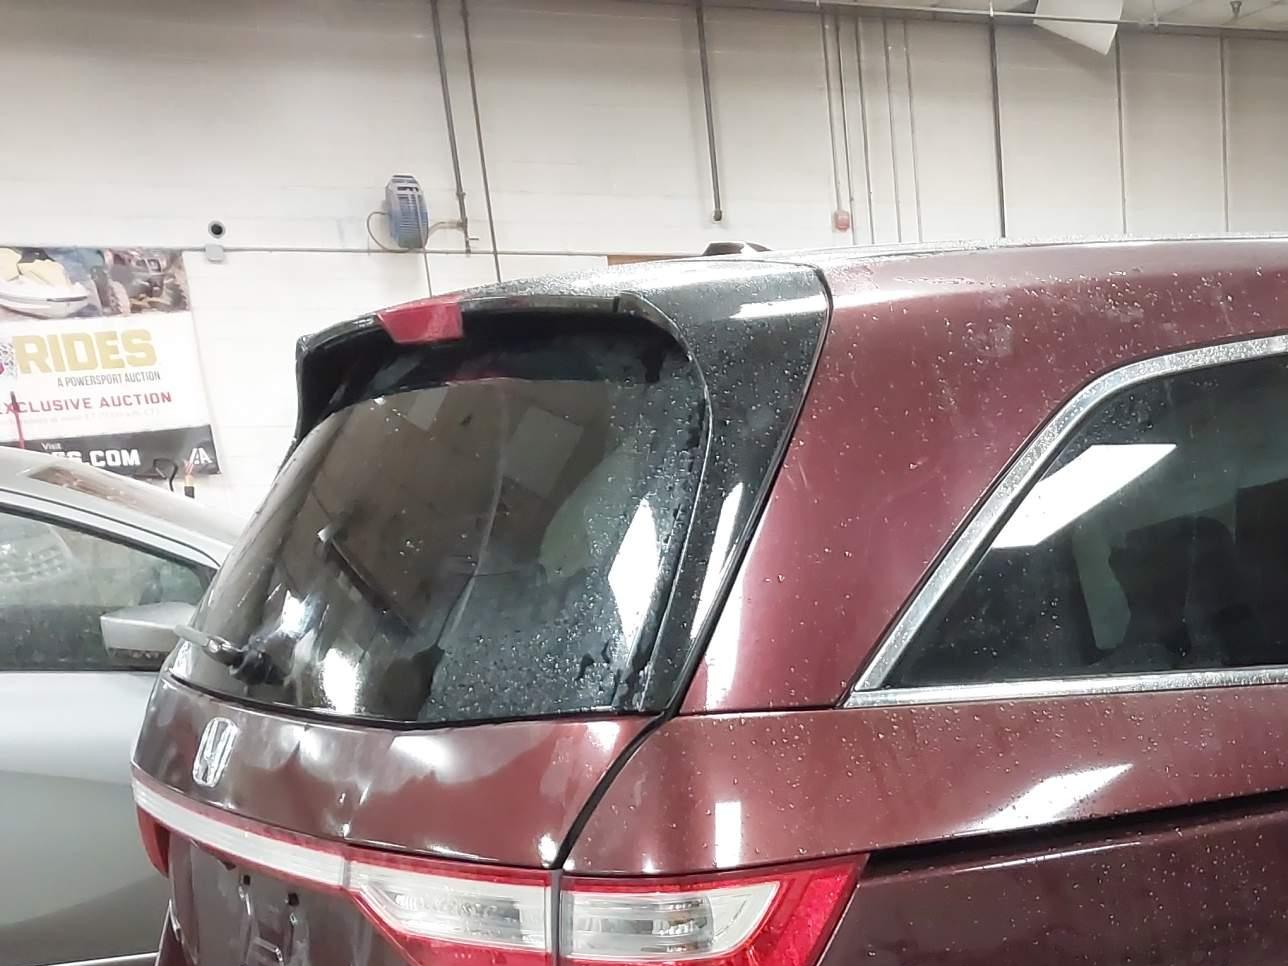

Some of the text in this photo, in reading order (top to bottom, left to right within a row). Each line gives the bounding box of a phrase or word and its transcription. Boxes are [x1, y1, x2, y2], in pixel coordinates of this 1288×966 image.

[12, 328, 158, 374] RIDES
[57, 370, 161, 388] A POWERSPORT AUCTION
[0, 391, 173, 414] XCLUSIVE AUCTION
[41, 441, 62, 451] Visit
